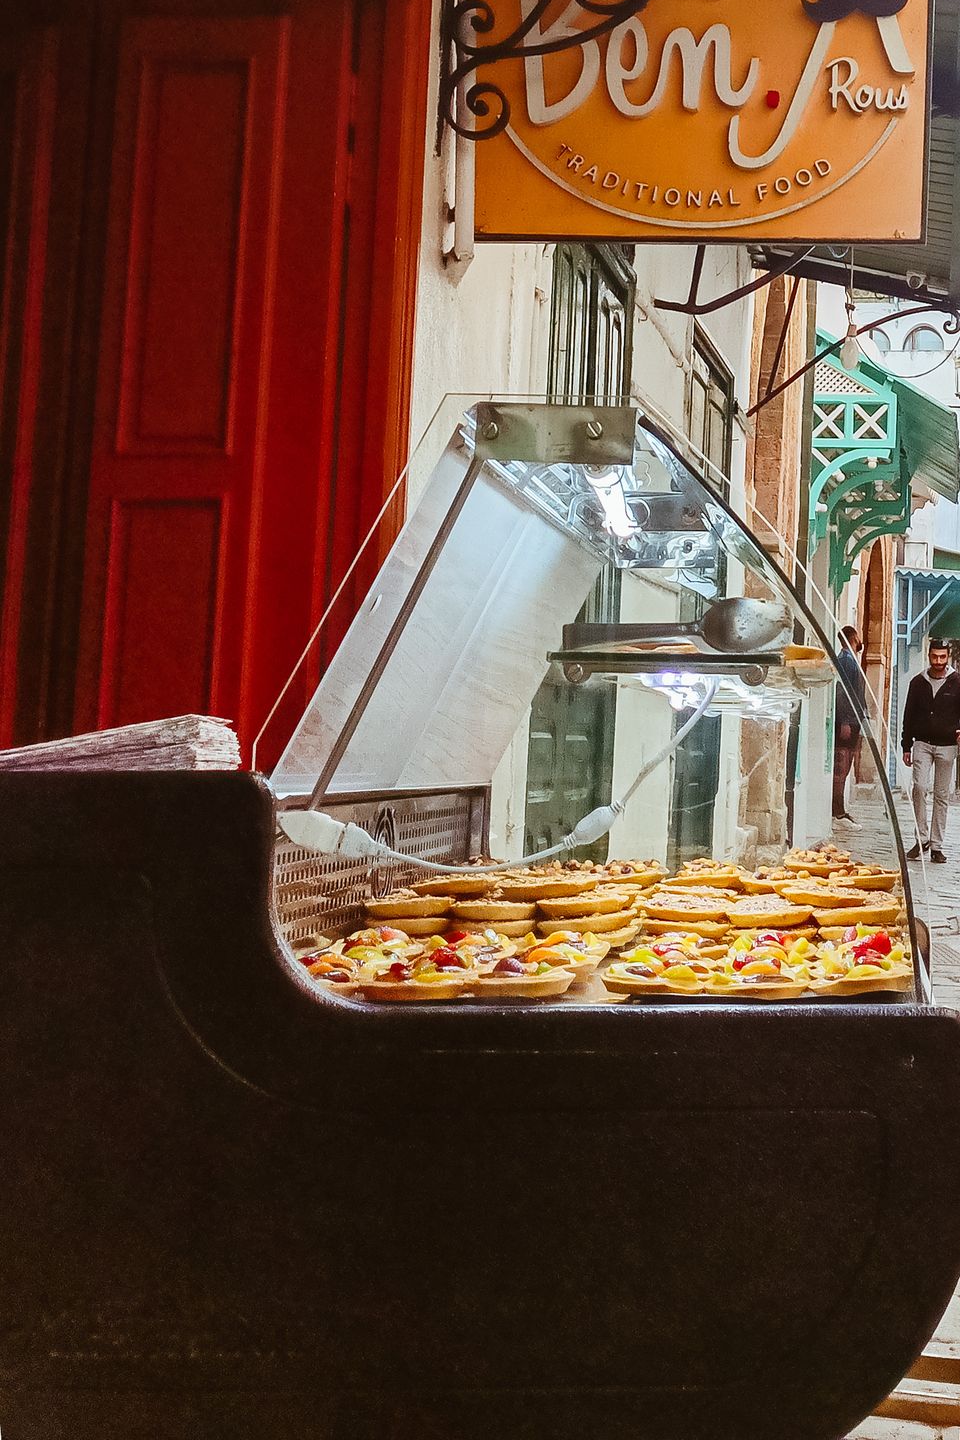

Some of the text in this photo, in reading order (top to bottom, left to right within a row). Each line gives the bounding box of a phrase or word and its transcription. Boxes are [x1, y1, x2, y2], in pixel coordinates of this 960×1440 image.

[826, 56, 909, 114] Rous
[556, 143, 833, 207] TRADITIONAL FOOD
